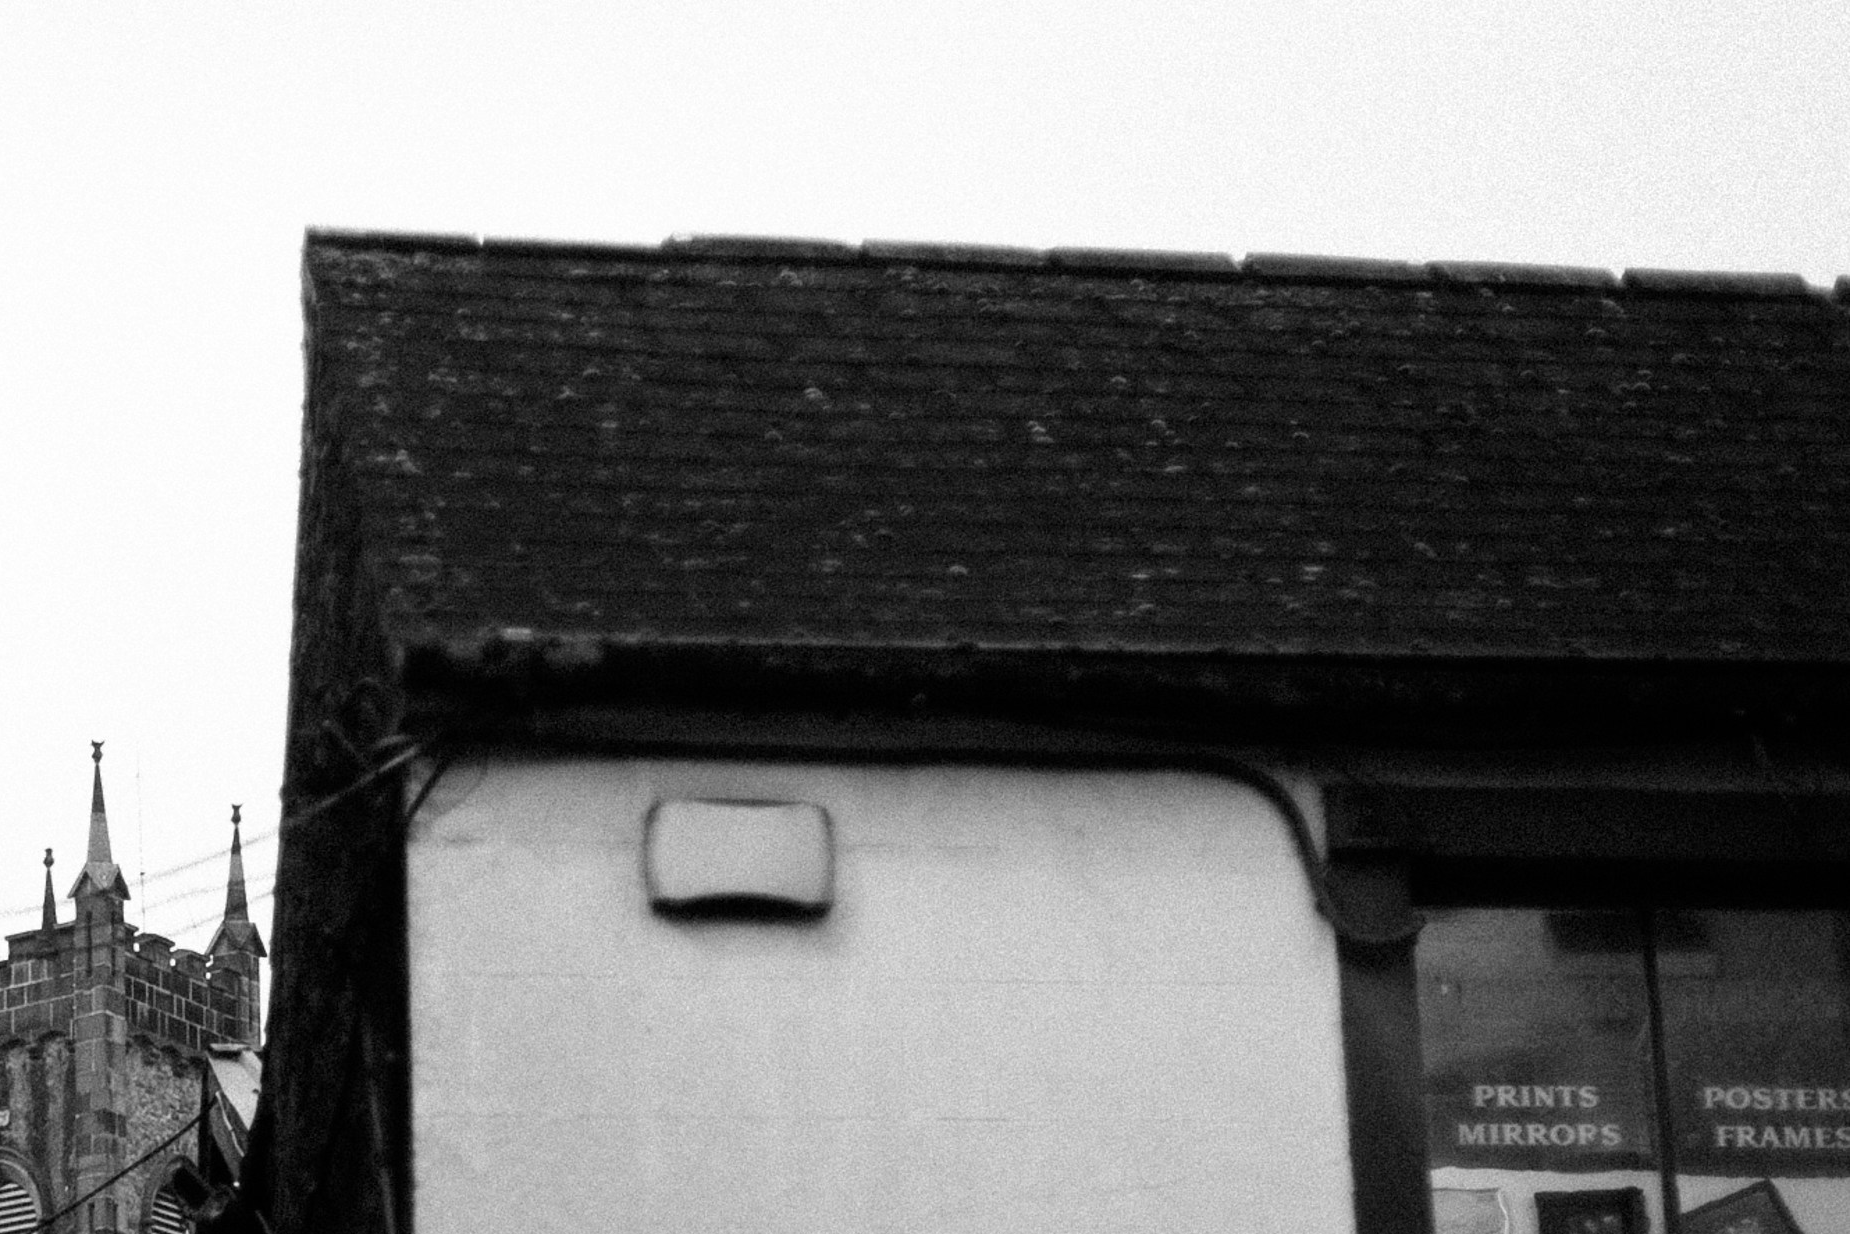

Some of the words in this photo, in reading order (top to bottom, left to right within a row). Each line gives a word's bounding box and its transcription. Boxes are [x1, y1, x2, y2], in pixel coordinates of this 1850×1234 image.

[1474, 1085, 1599, 1108] PRINTS
[1703, 1086, 1850, 1110] POSTERS
[1716, 1125, 1850, 1148] FRAMES
